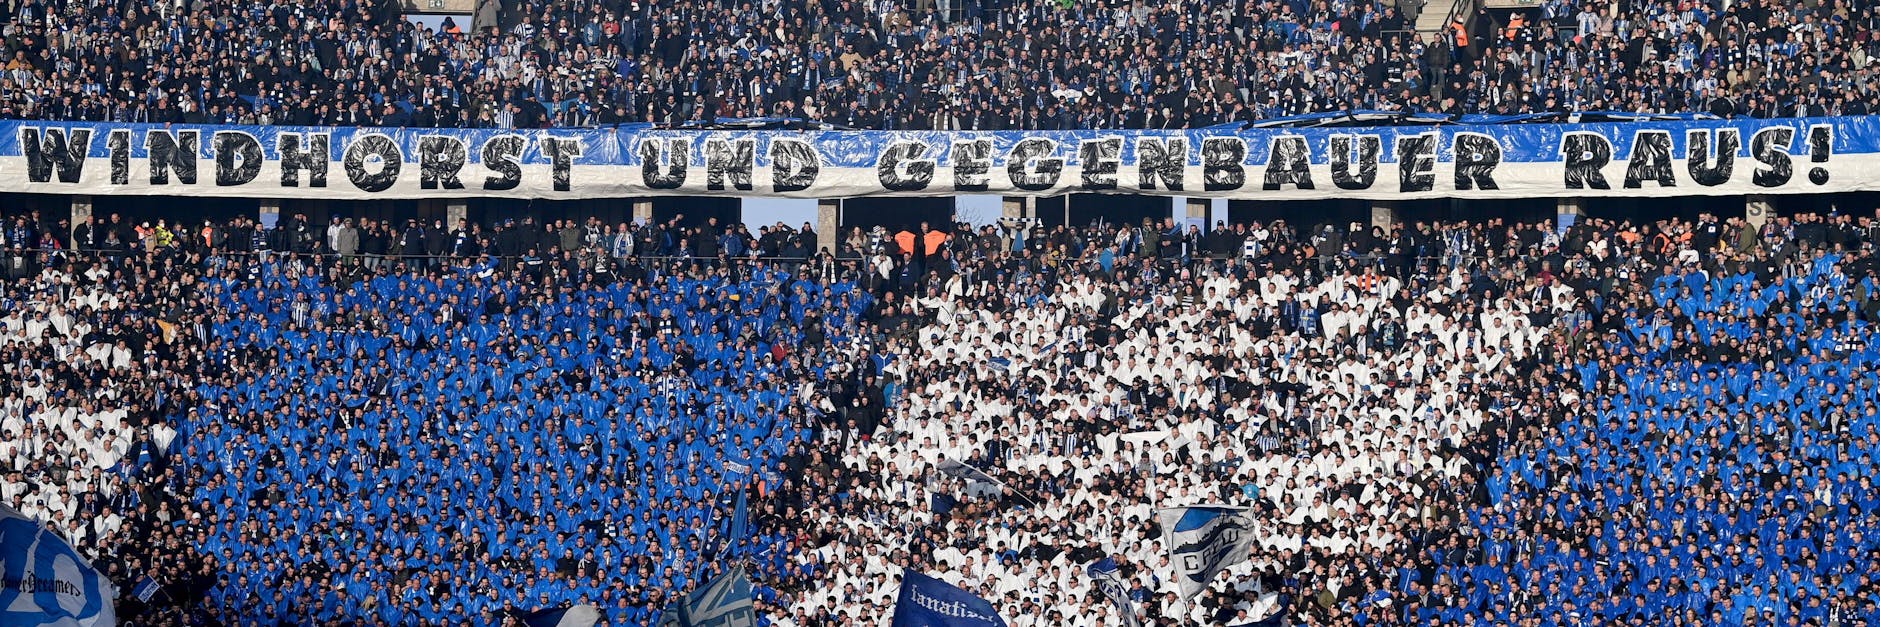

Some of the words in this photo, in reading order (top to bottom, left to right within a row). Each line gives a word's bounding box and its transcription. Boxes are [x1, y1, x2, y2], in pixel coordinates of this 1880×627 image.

[22, 127, 582, 192] WINDHORST
[640, 138, 820, 192] UND
[878, 132, 1501, 192] GEGENBAUER
[1561, 126, 1833, 190] RAUS!
[909, 583, 998, 627] fanati
